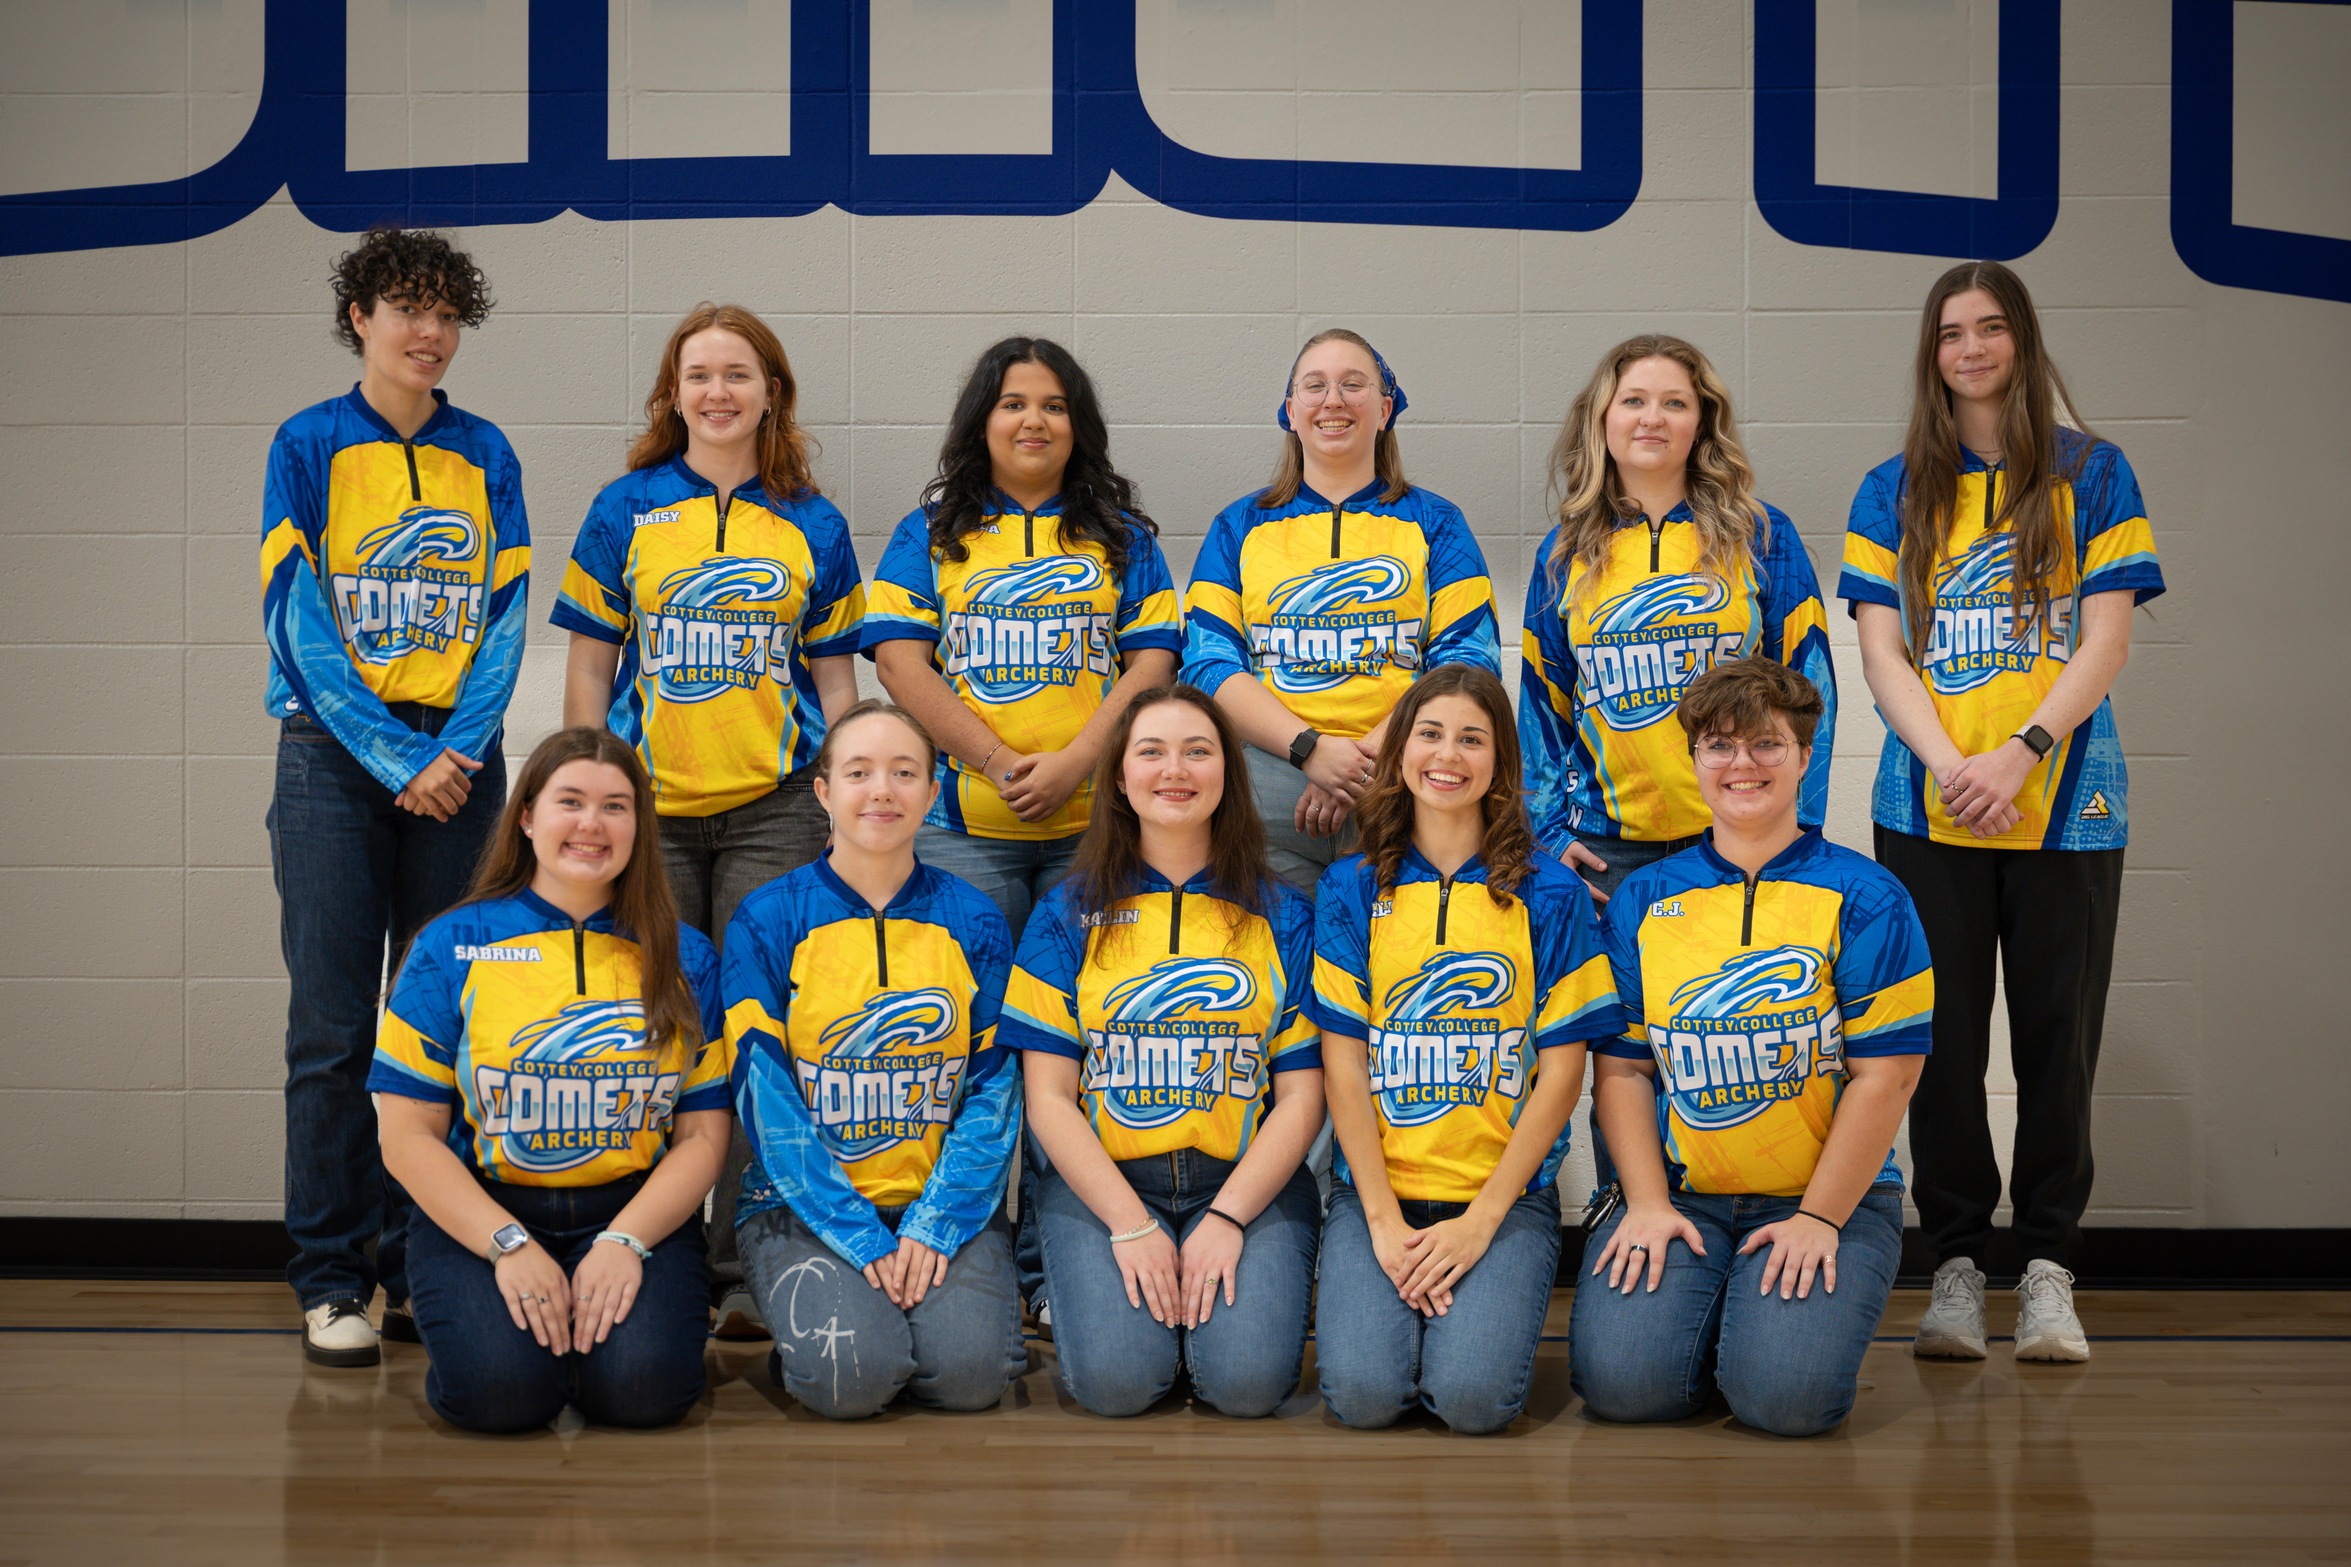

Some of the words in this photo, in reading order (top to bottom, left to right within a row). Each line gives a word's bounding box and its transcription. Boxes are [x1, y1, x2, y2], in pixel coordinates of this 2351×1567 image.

[633, 511, 680, 526] DAISY
[361, 566, 416, 580] COTTEY
[416, 565, 469, 584] COLLEGE
[969, 604, 1023, 618] COTTEY
[1027, 603, 1091, 619] COLLEGE
[1936, 596, 1981, 609] OTTEY
[663, 605, 712, 620] COTTEY
[717, 608, 773, 623] COLLEGE
[1273, 615, 1328, 628] COTTEY
[1330, 612, 1395, 627] COLLEGE
[377, 624, 450, 651] ARHERY
[1594, 632, 1650, 645] COTTEY
[1652, 625, 1715, 641] COLLEGE
[1923, 596, 2072, 666] OMETS
[642, 614, 791, 684] COMETS
[947, 615, 1112, 676] COMETS
[1251, 620, 1422, 669] COMETS
[1946, 652, 2033, 675] ARCHERY
[673, 667, 758, 688] ARCHERY
[985, 666, 1077, 684] ARCHERY
[1618, 687, 1688, 712] ARCHE
[1652, 902, 1684, 917] C.J.
[455, 945, 542, 962] SABRINA
[1108, 1022, 1165, 1035] COTTEY
[1172, 1023, 1237, 1036] COLLEGE
[1386, 1020, 1433, 1032] COTTEY
[1439, 1021, 1497, 1032] COLLEGE
[1672, 1018, 1738, 1031] COTTEY
[1738, 1009, 1816, 1031] COLLEGE
[1649, 1006, 1844, 1093] COMETS
[513, 1061, 580, 1077] COTTEY
[583, 1062, 656, 1077] COLLEGE
[823, 1056, 878, 1071] COTTEY
[883, 1053, 941, 1069] COLLEGE
[1088, 1030, 1260, 1098] COMETS
[1368, 1027, 1527, 1097] COMETS
[476, 1066, 680, 1133] COMETS
[796, 1058, 965, 1125] COMETS
[1126, 1088, 1215, 1108] ARCHERY
[1396, 1085, 1484, 1106] ARCHERY
[1699, 1080, 1803, 1109] ARCHERY
